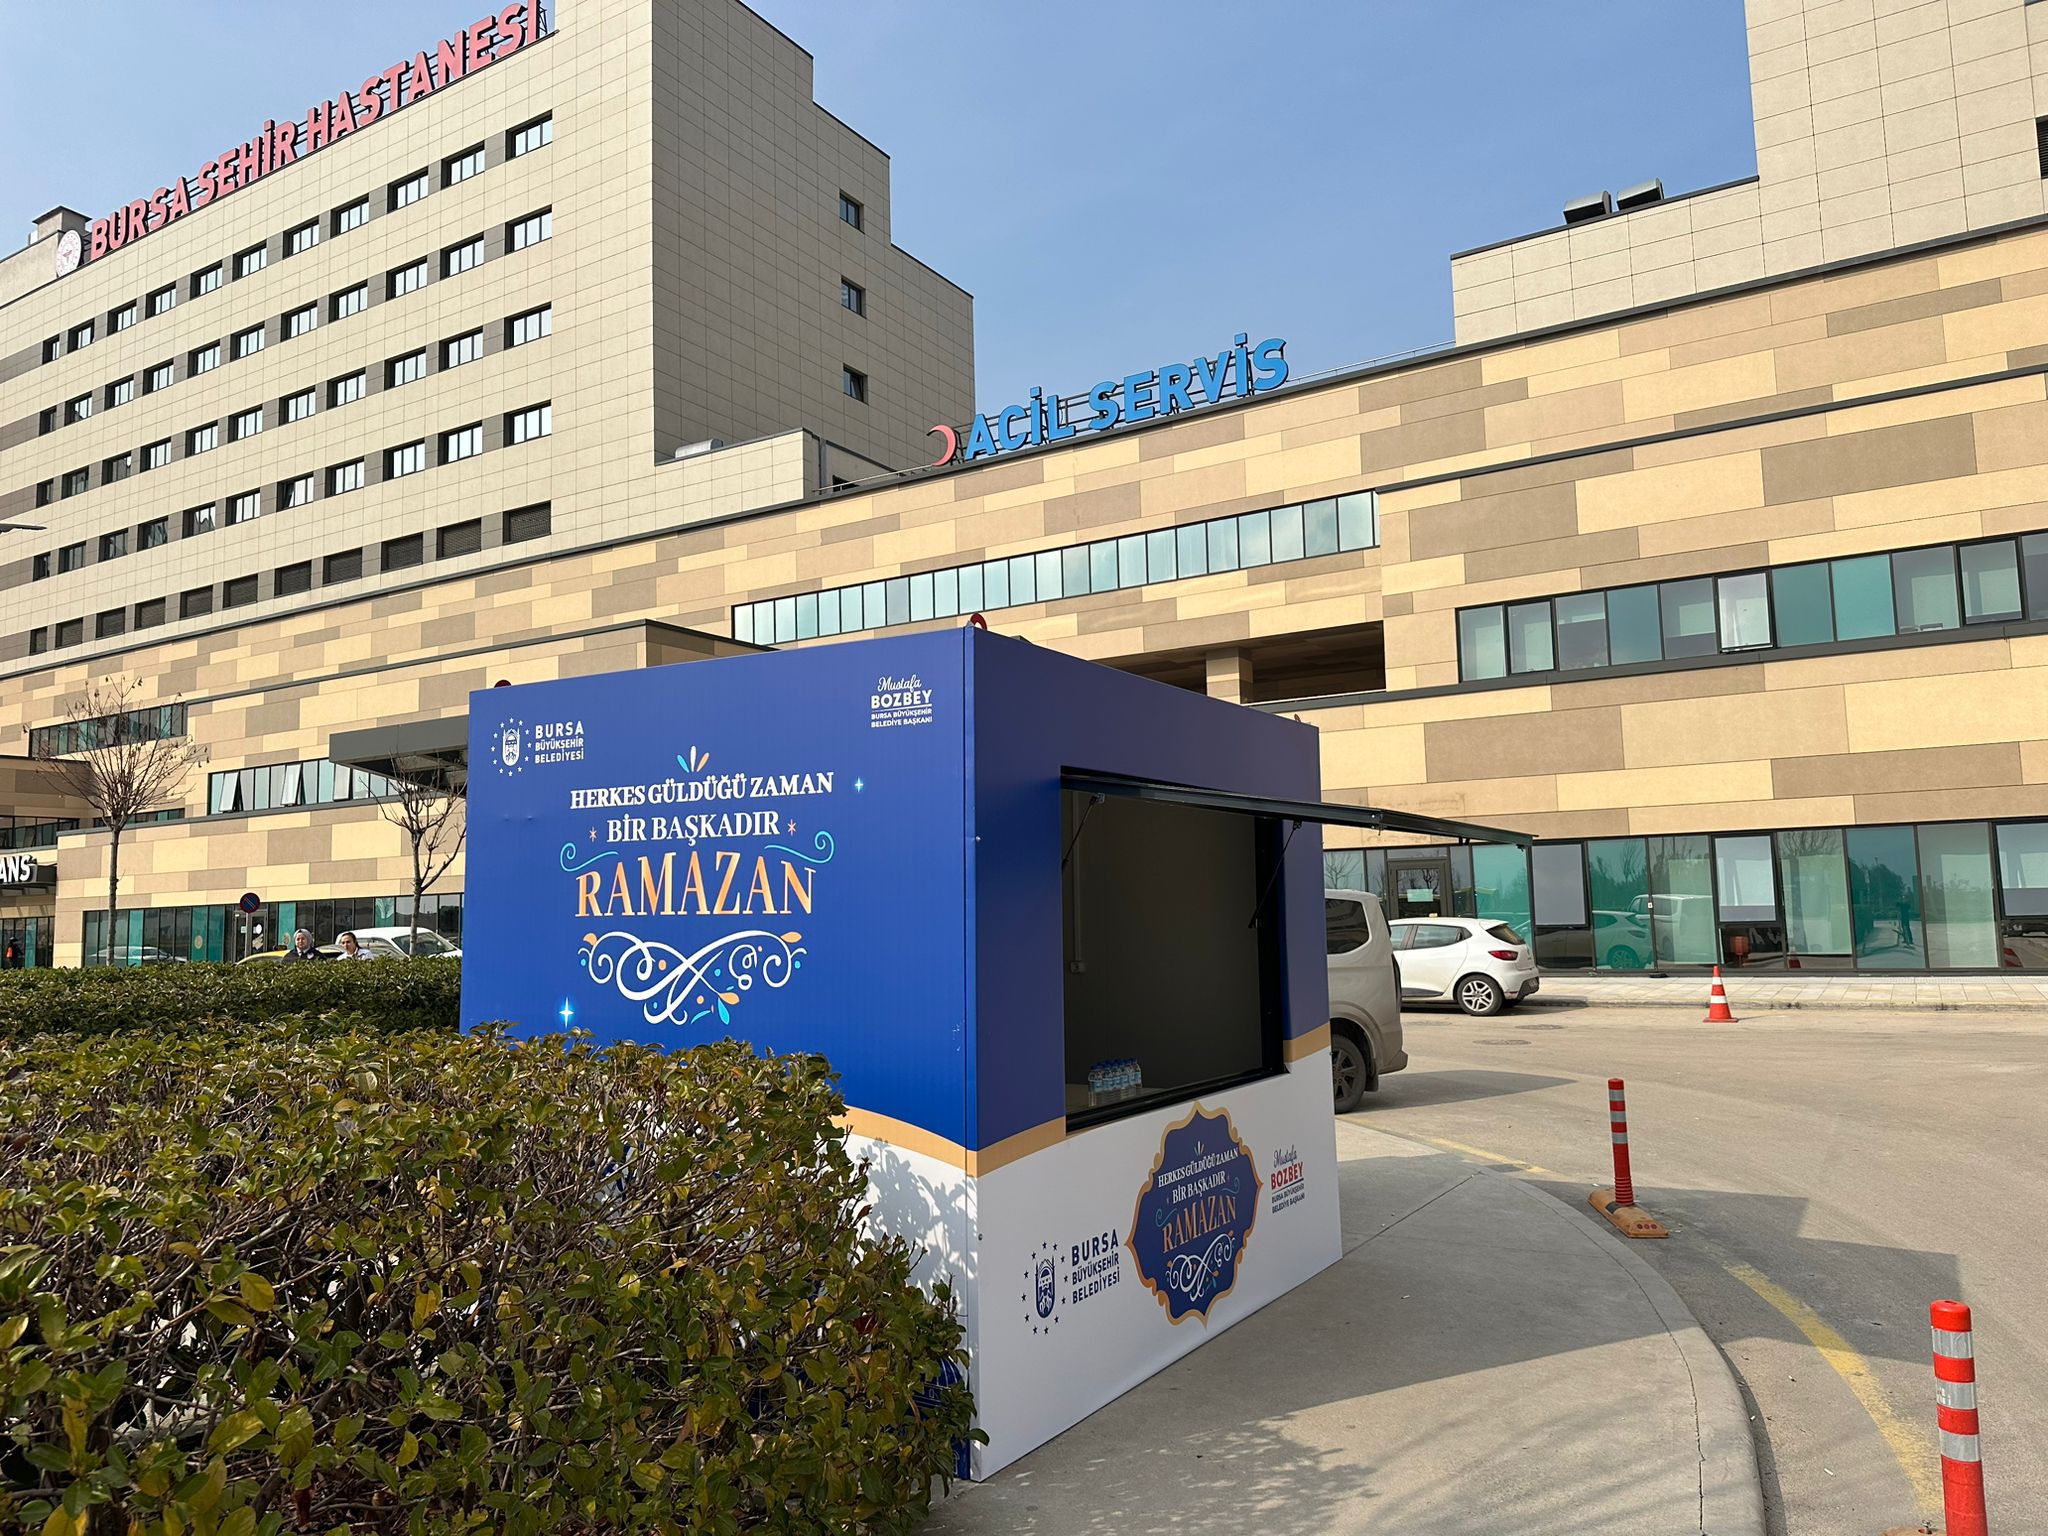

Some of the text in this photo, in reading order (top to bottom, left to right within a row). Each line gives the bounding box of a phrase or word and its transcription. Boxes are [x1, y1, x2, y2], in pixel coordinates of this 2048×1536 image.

[90, 176, 192, 260] BURSA
[965, 332, 1289, 460] ACİL SERVİS
[871, 690, 932, 709] BOZBEY
[877, 674, 922, 692] Mustafa
[535, 721, 584, 739] BURSA
[871, 707, 932, 720] BURSA BÜYÜKŞEHİR
[871, 716, 933, 728] BELEDİYE BAŞKANI
[534, 748, 584, 764] BELEDİYESİ
[570, 771, 834, 809] HERKES GÜLDÜĞÜ ZAMAN
[607, 810, 780, 846] BİR BAŞKADIR
[575, 850, 817, 917] RAMAZAN
[1158, 1147, 1239, 1188] HERKES GÜLDÜĞÜ ZAMAN
[1271, 1161, 1304, 1190] BOZBEY
[1172, 1170, 1226, 1204] BİR BAŞKADIR
[1162, 1195, 1236, 1253] RAMAZAN
[1071, 1228, 1119, 1267] BURSA
[1072, 1266, 1120, 1305] BELEDİYESİ
